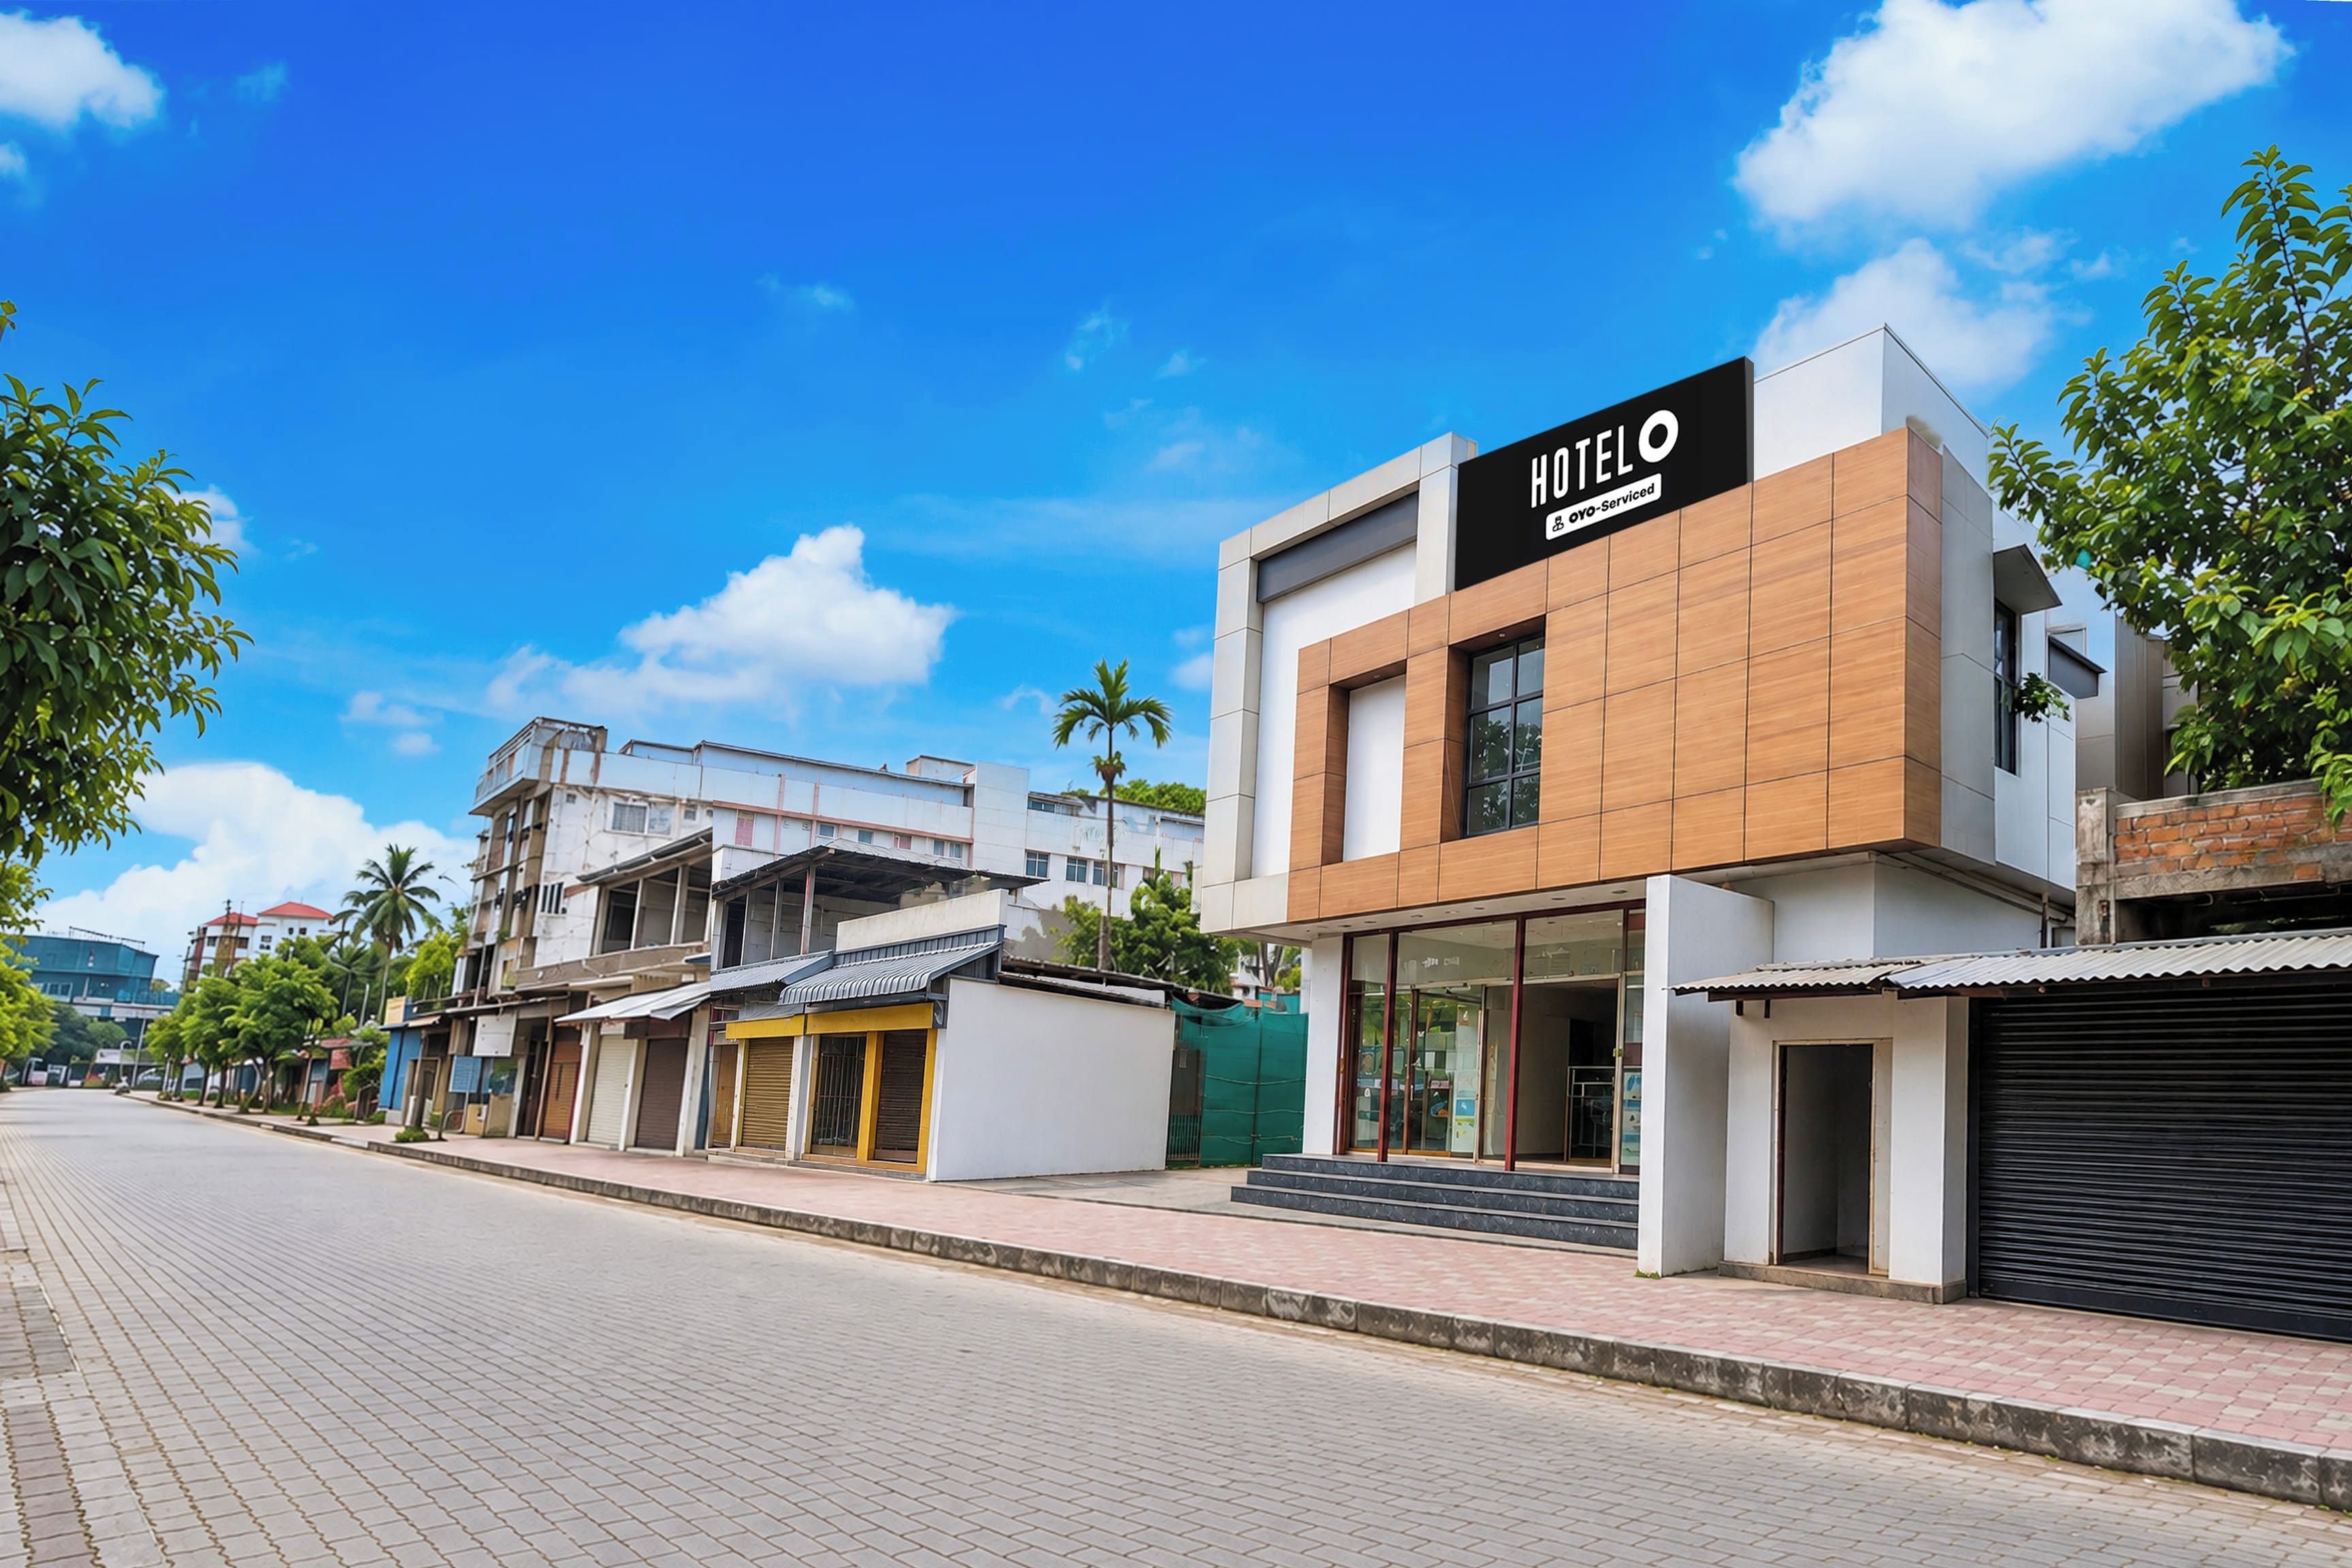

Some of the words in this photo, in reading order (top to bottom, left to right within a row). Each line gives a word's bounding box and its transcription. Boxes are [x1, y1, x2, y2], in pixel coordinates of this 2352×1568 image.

[1531, 425, 1633, 508] HOTEL
[1638, 410, 1679, 463] O
[1569, 483, 1654, 523] OYO-Serviced
